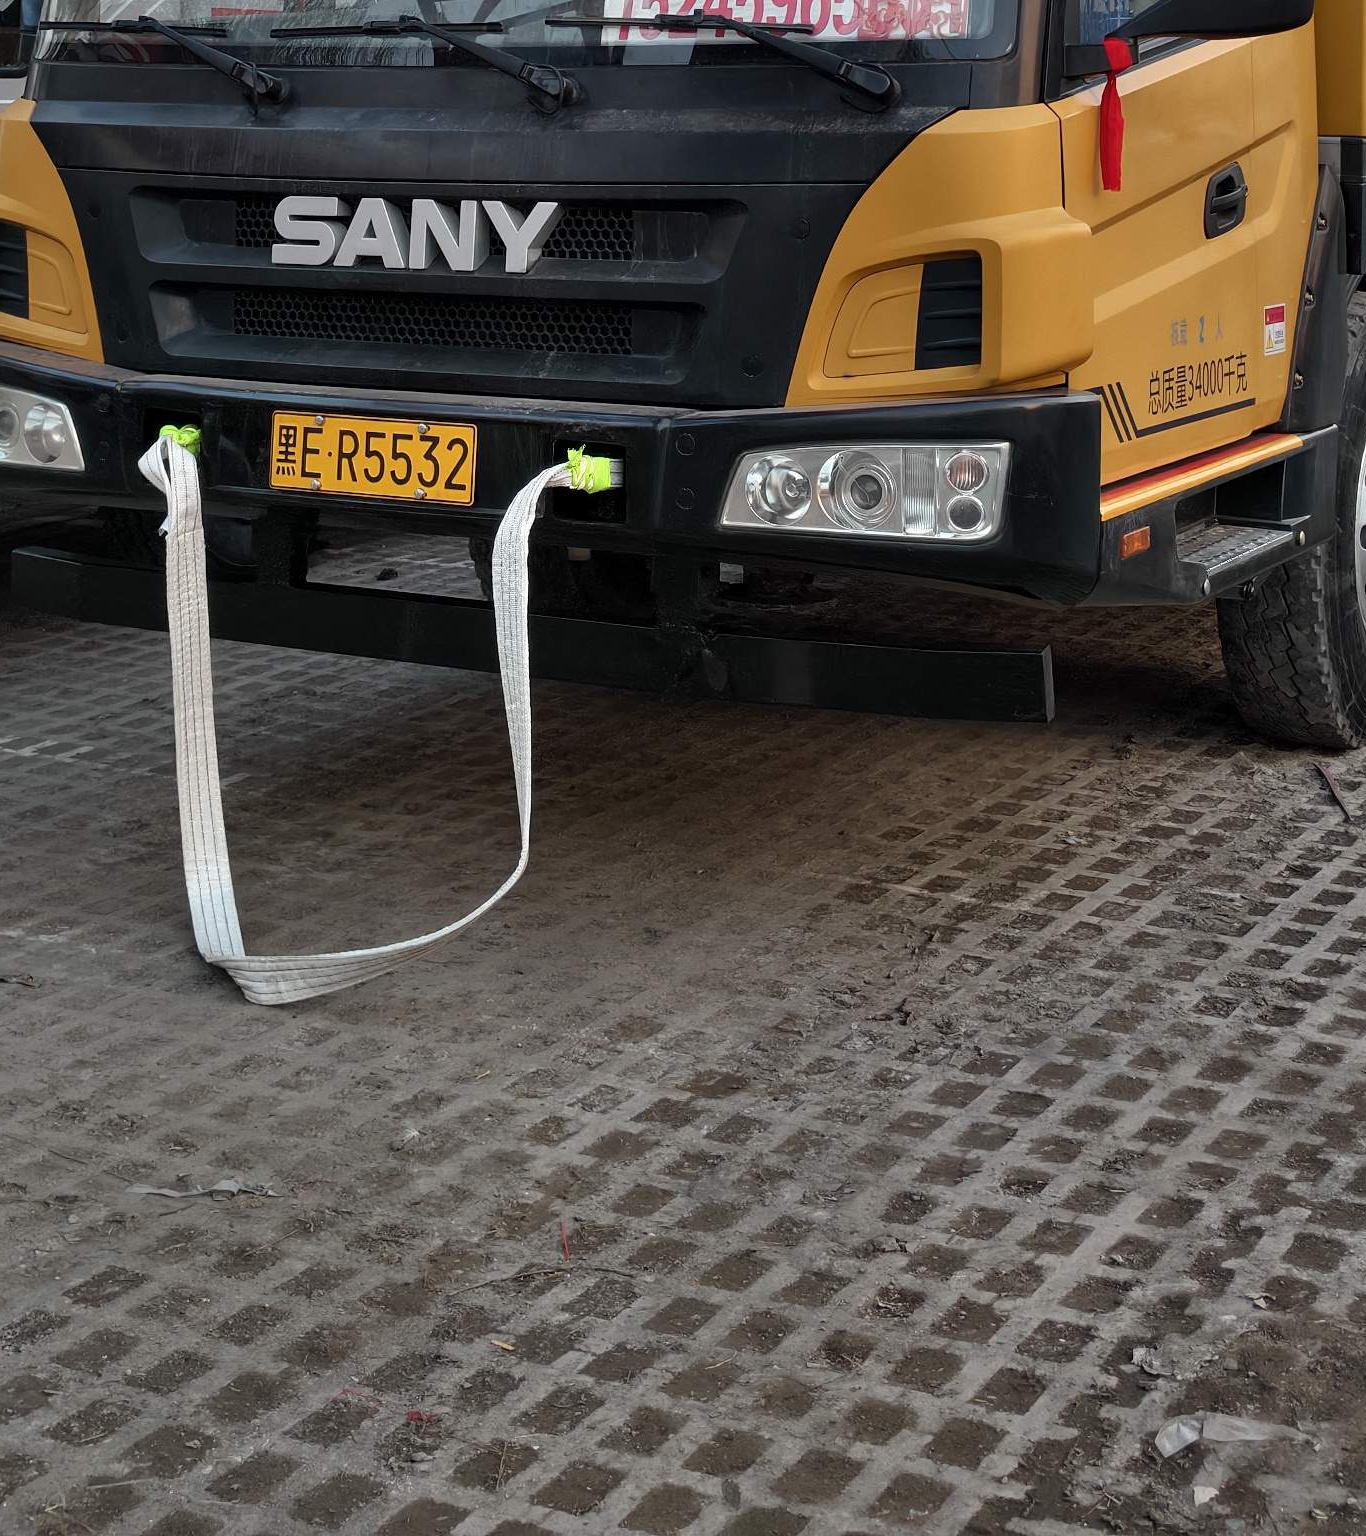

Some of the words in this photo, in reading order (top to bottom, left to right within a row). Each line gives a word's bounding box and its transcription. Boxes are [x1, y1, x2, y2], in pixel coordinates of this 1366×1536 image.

[271, 196, 558, 273] SANY
[1148, 351, 1248, 415] 总质量34000千克
[275, 424, 469, 491] 黑E·R5532
